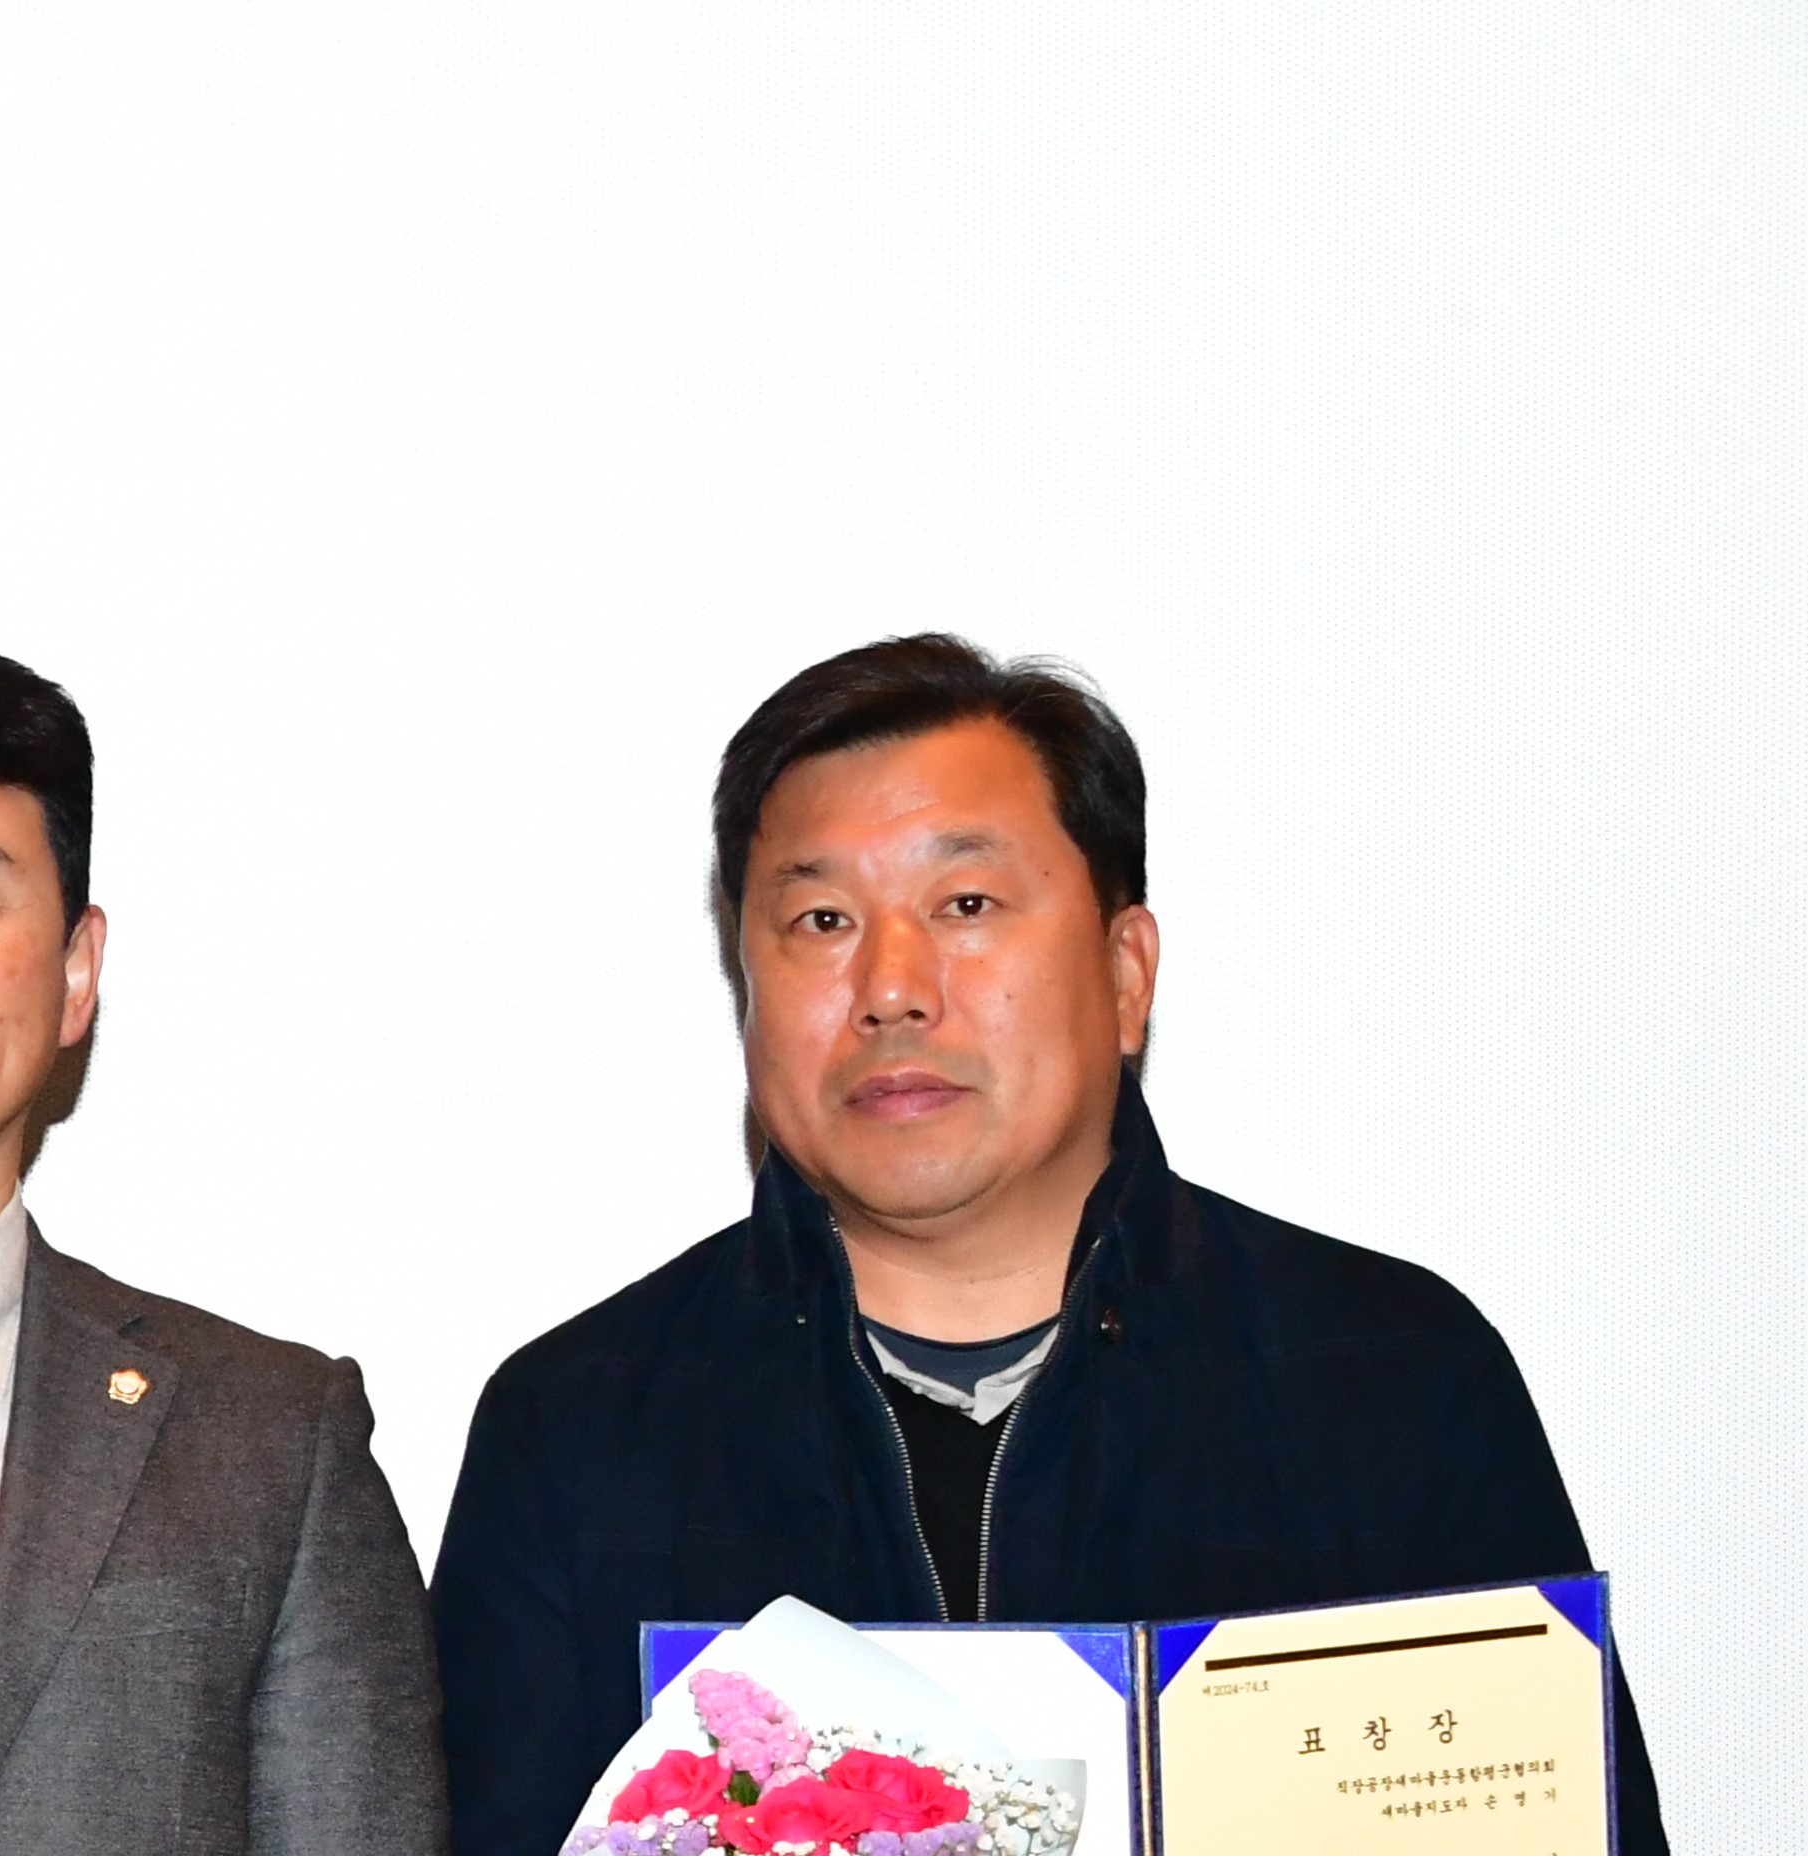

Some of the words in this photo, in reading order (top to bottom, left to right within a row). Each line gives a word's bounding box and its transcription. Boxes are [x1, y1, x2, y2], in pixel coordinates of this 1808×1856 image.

[1297, 1726, 1326, 1755] 표
[1362, 1715, 1392, 1751] 창
[1427, 1708, 1458, 1744] 장
